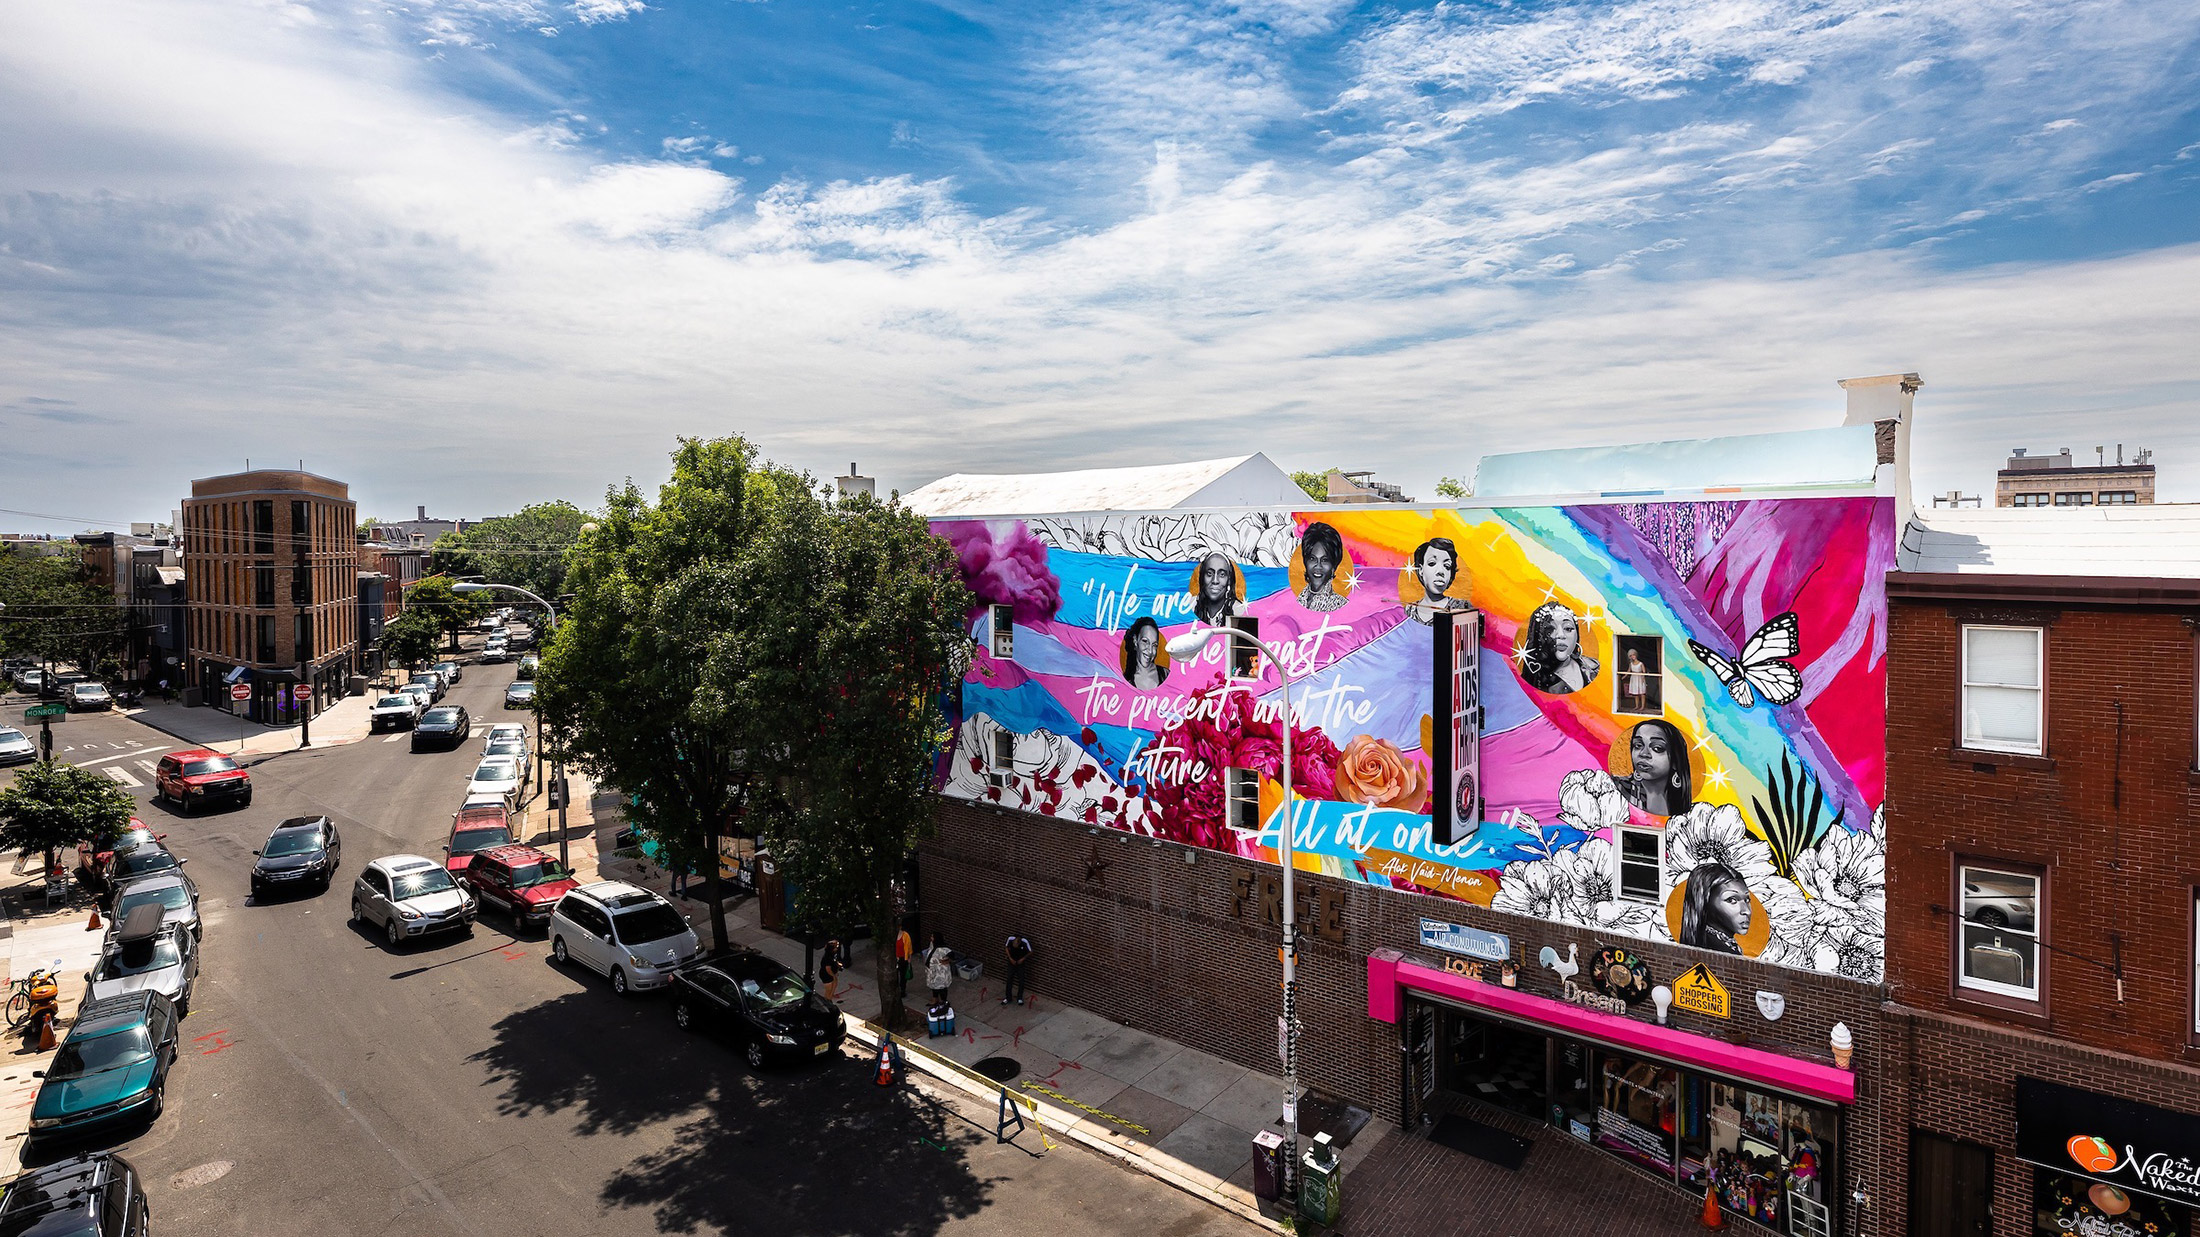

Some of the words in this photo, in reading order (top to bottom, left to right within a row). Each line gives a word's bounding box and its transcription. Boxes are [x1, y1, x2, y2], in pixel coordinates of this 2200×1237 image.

[1152, 591, 1198, 619] are
[1179, 622, 1226, 675] he
[1257, 614, 1353, 682] past,
[1454, 622, 1477, 671] PHILLY
[1075, 672, 1124, 724] the
[1127, 678, 1253, 732] present,
[1252, 685, 1316, 731] and
[1310, 673, 1379, 736] the
[1453, 668, 1477, 714] AIDS
[27, 708, 56, 717] MONROE
[1453, 711, 1477, 771] THRIFT
[1123, 736, 1217, 790] future.
[1253, 798, 1328, 866] All
[1335, 800, 1418, 854] at
[1411, 860, 1483, 890] Vaid-Menon
[1230, 869, 1346, 943] FREE
[1433, 931, 1446, 945] AIR
[1450, 934, 1500, 957] CONDITIONED
[1444, 957, 1483, 982] LOVE
[1564, 980, 1627, 1015] Dream
[1679, 986, 1723, 1005] SHOPPERS
[1679, 995, 1723, 1014] CROSSING
[2108, 1144, 2200, 1186] Naked
[2175, 1161, 2194, 1171] The
